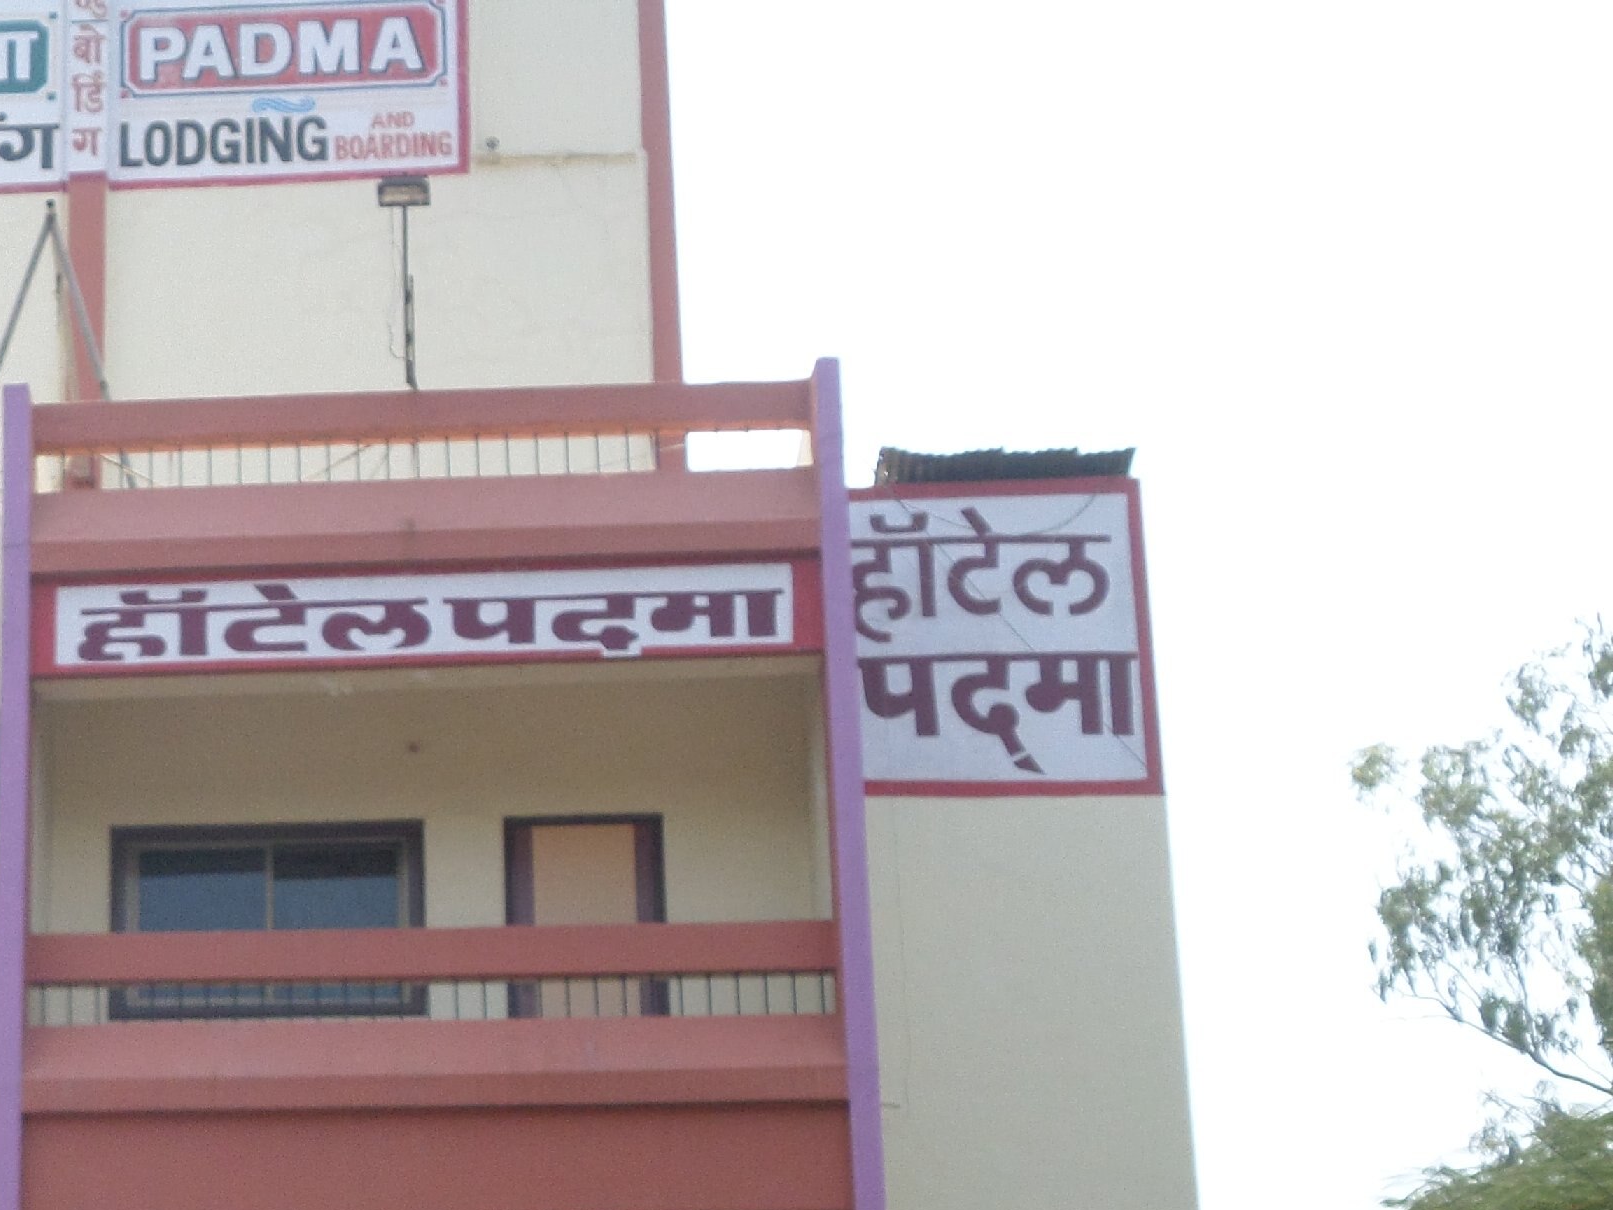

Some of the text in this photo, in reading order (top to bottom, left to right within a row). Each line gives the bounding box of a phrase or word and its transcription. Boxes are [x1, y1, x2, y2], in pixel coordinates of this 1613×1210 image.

[138, 16, 425, 83] PADMA
[119, 114, 329, 168] LODGING
[333, 132, 453, 161] BOARDING
[371, 111, 415, 128] AND
[851, 506, 1112, 644] हॉटेल
[78, 583, 430, 662] हॉटेल
